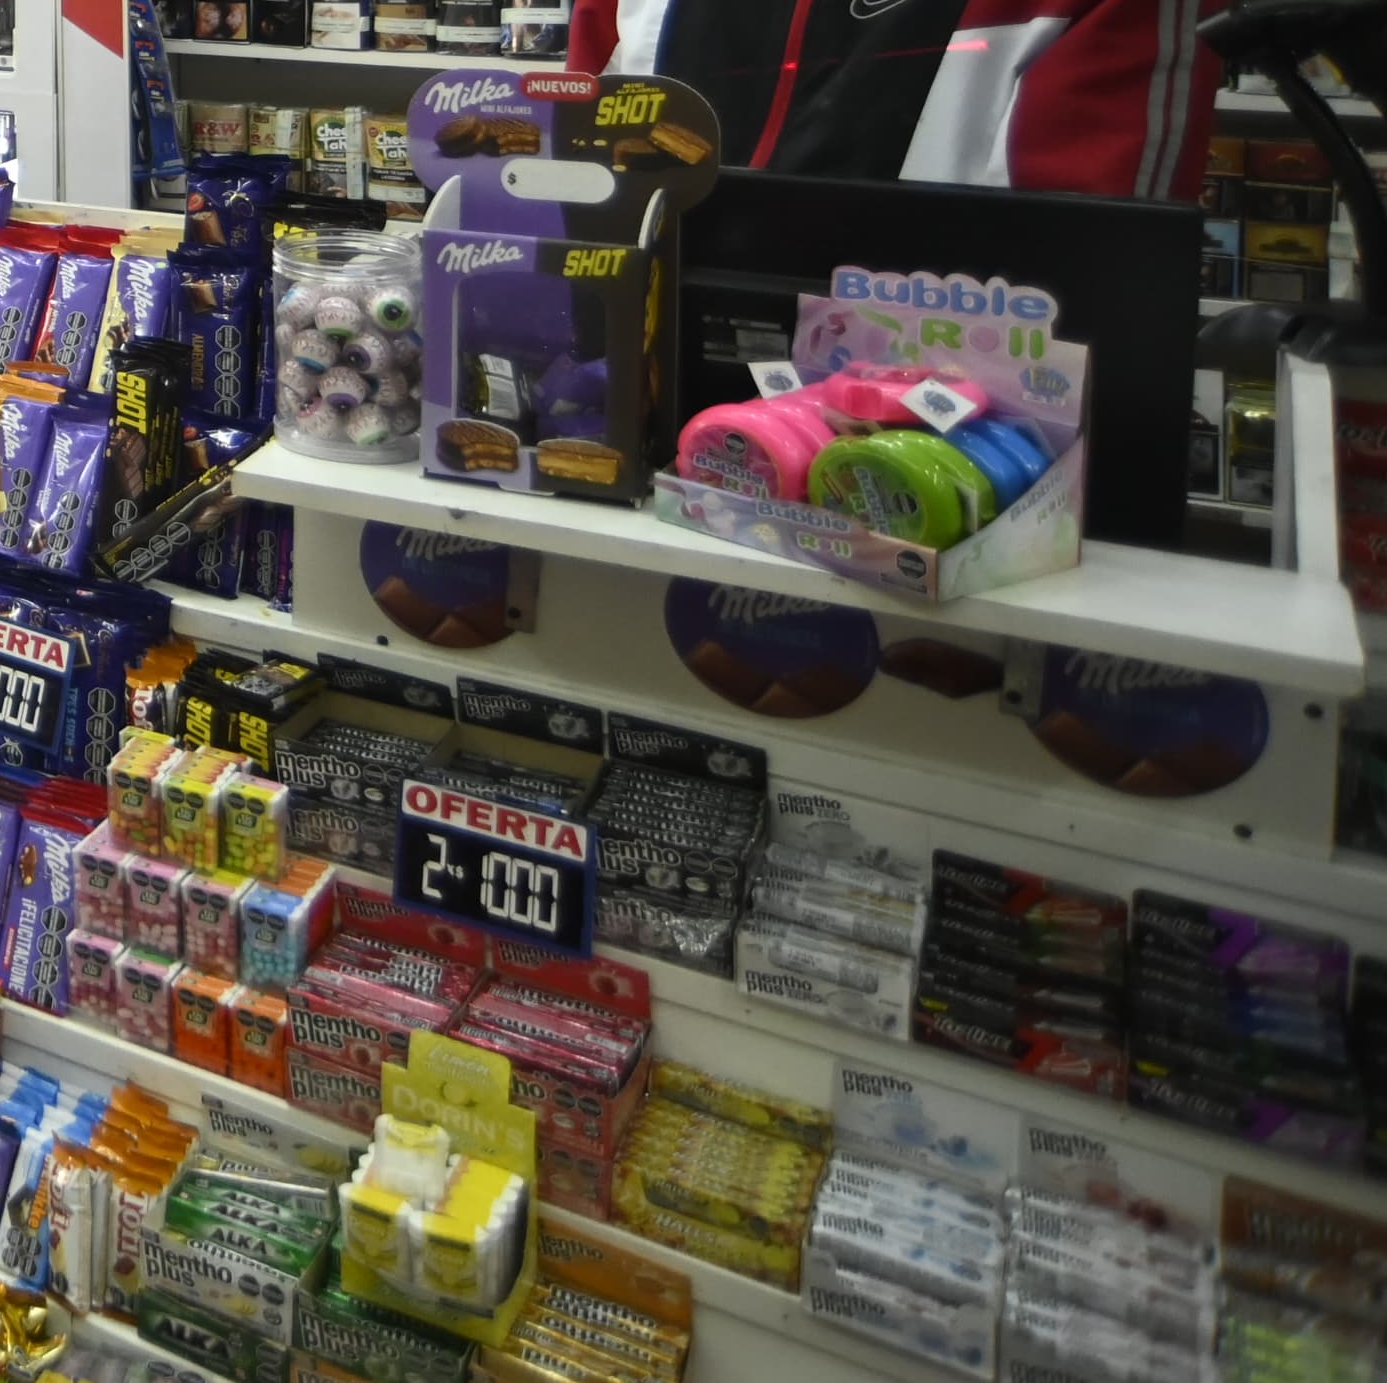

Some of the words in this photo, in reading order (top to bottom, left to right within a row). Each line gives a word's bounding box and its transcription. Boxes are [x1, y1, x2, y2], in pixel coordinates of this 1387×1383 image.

[425, 77, 516, 115] Milka
[526, 80, 592, 95] ¡NUEVOS!
[595, 93, 667, 126] SHOT
[193, 120, 240, 138] R&W
[507, 172, 517, 185] $
[437, 239, 524, 274] Milka
[563, 248, 627, 277] SHOT
[835, 270, 1050, 321] Bubble
[921, 319, 1045, 360] Roll
[116, 372, 147, 434] SHOT
[694, 454, 766, 487] Bubble
[756, 499, 851, 534] Bubble
[465, 692, 531, 712] mentho
[275, 750, 360, 779] mentho
[277, 767, 326, 788] plus
[778, 793, 841, 811] mentho
[778, 802, 816, 817] plus
[405, 783, 585, 858] OFERTA
[480, 851, 559, 933] 1000
[292, 1007, 381, 1044] mentho
[293, 1025, 344, 1050] plus
[292, 1068, 380, 1100] mentho
[293, 1083, 343, 1105] plus
[210, 1122, 247, 1139] plus
[393, 1085, 526, 1151] DORIN'S
[210, 1227, 268, 1256] ALKA
[144, 1240, 233, 1285] mentho
[145, 1263, 196, 1289] plus
